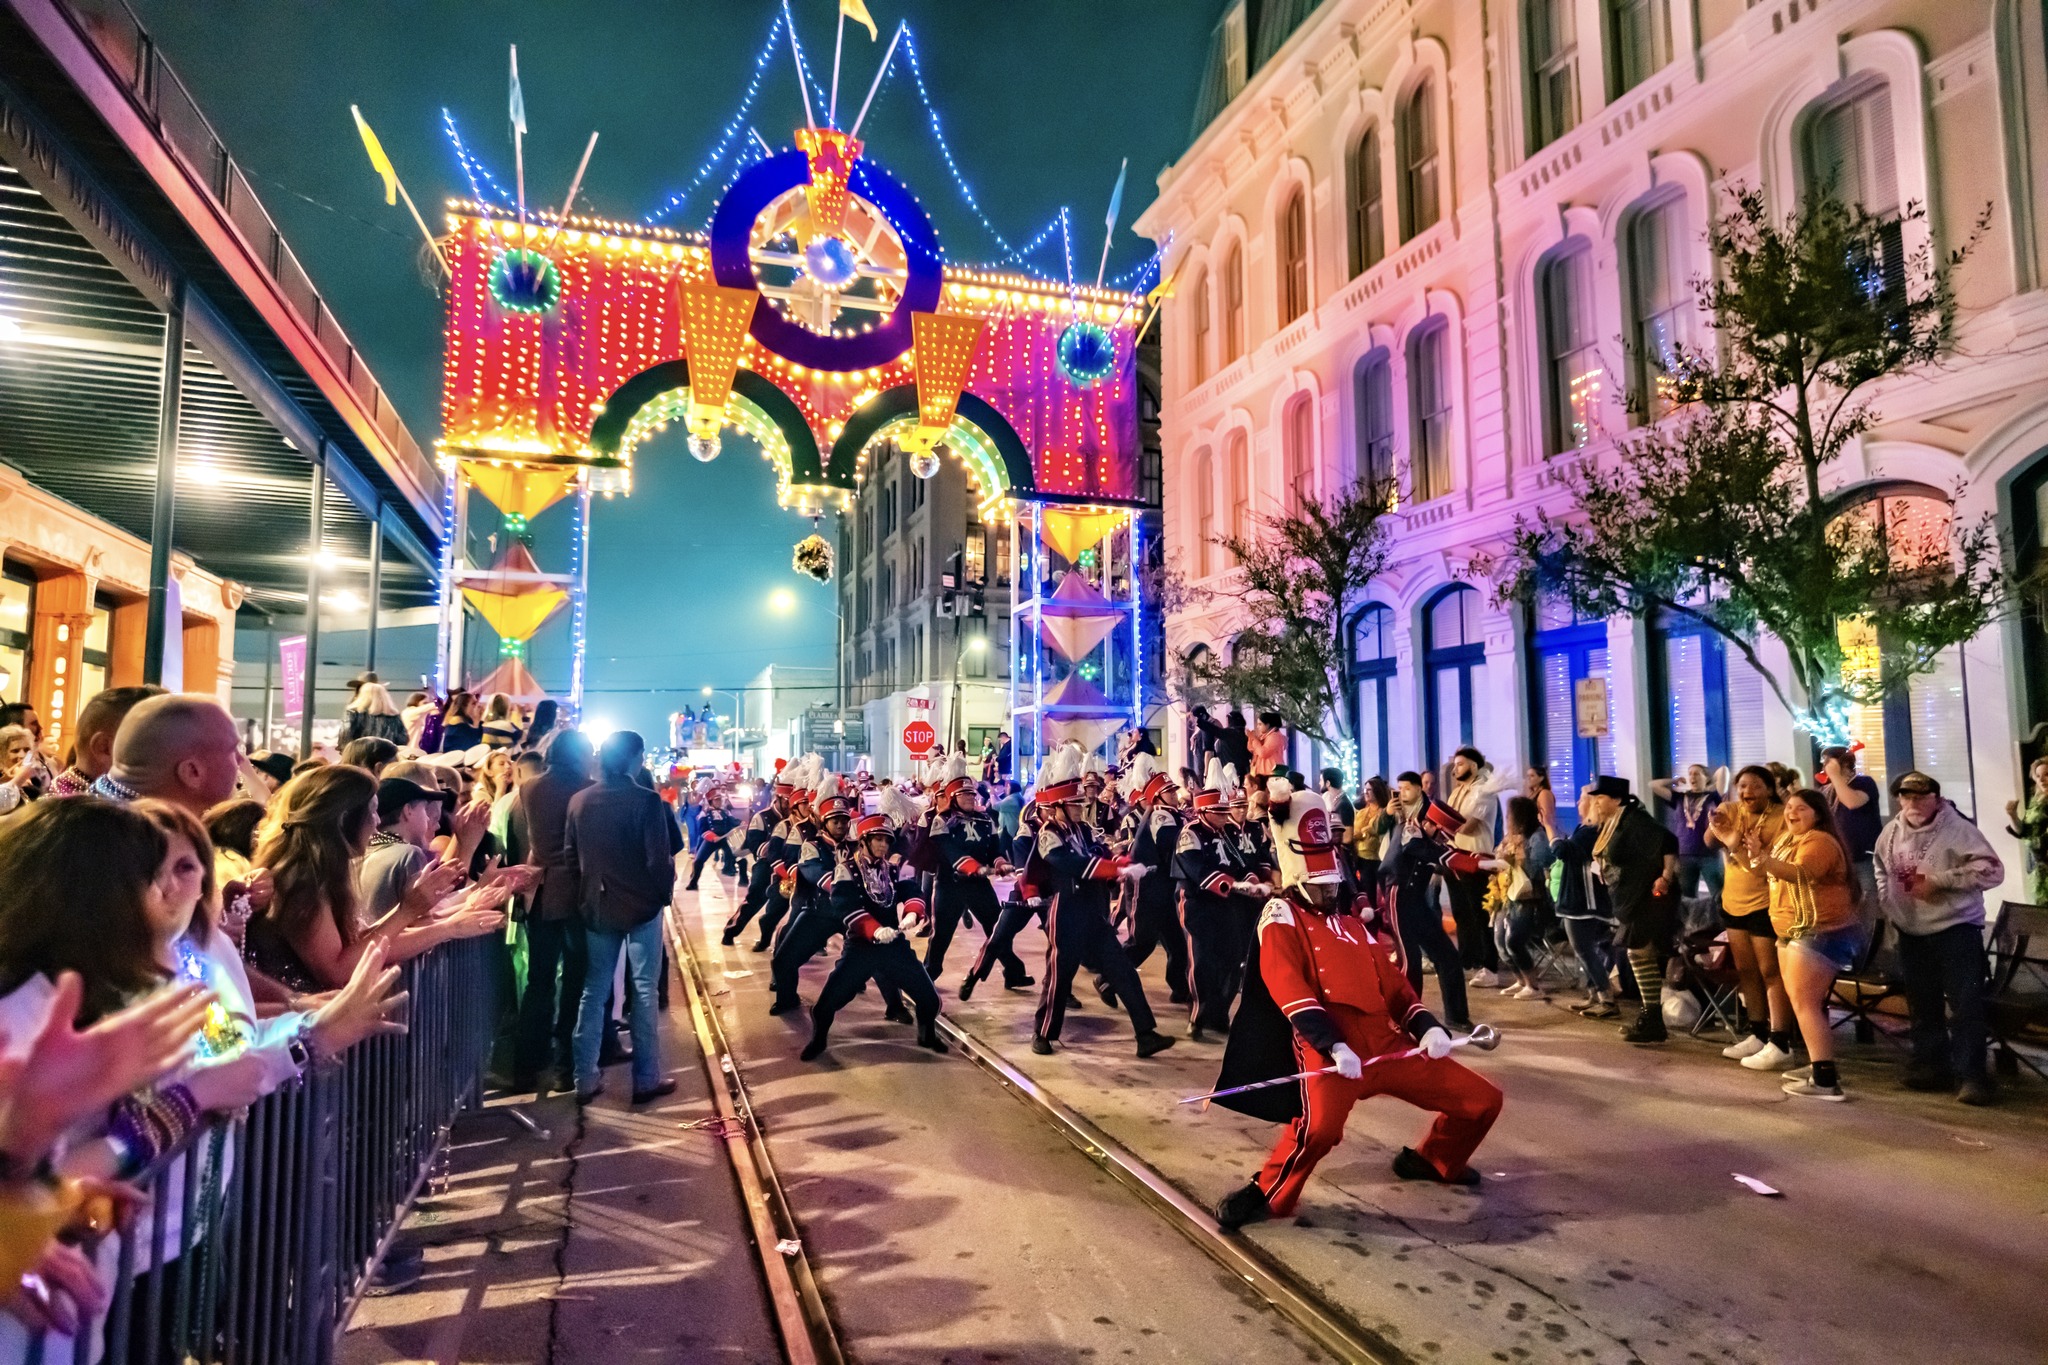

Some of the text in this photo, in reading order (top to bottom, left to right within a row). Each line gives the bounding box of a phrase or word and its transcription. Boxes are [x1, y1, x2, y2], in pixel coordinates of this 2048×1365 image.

[286, 652, 296, 704] SOCIETY
[1585, 682, 1597, 690] NO
[1579, 693, 1604, 701] PARKING
[905, 731, 933, 743] STOP
